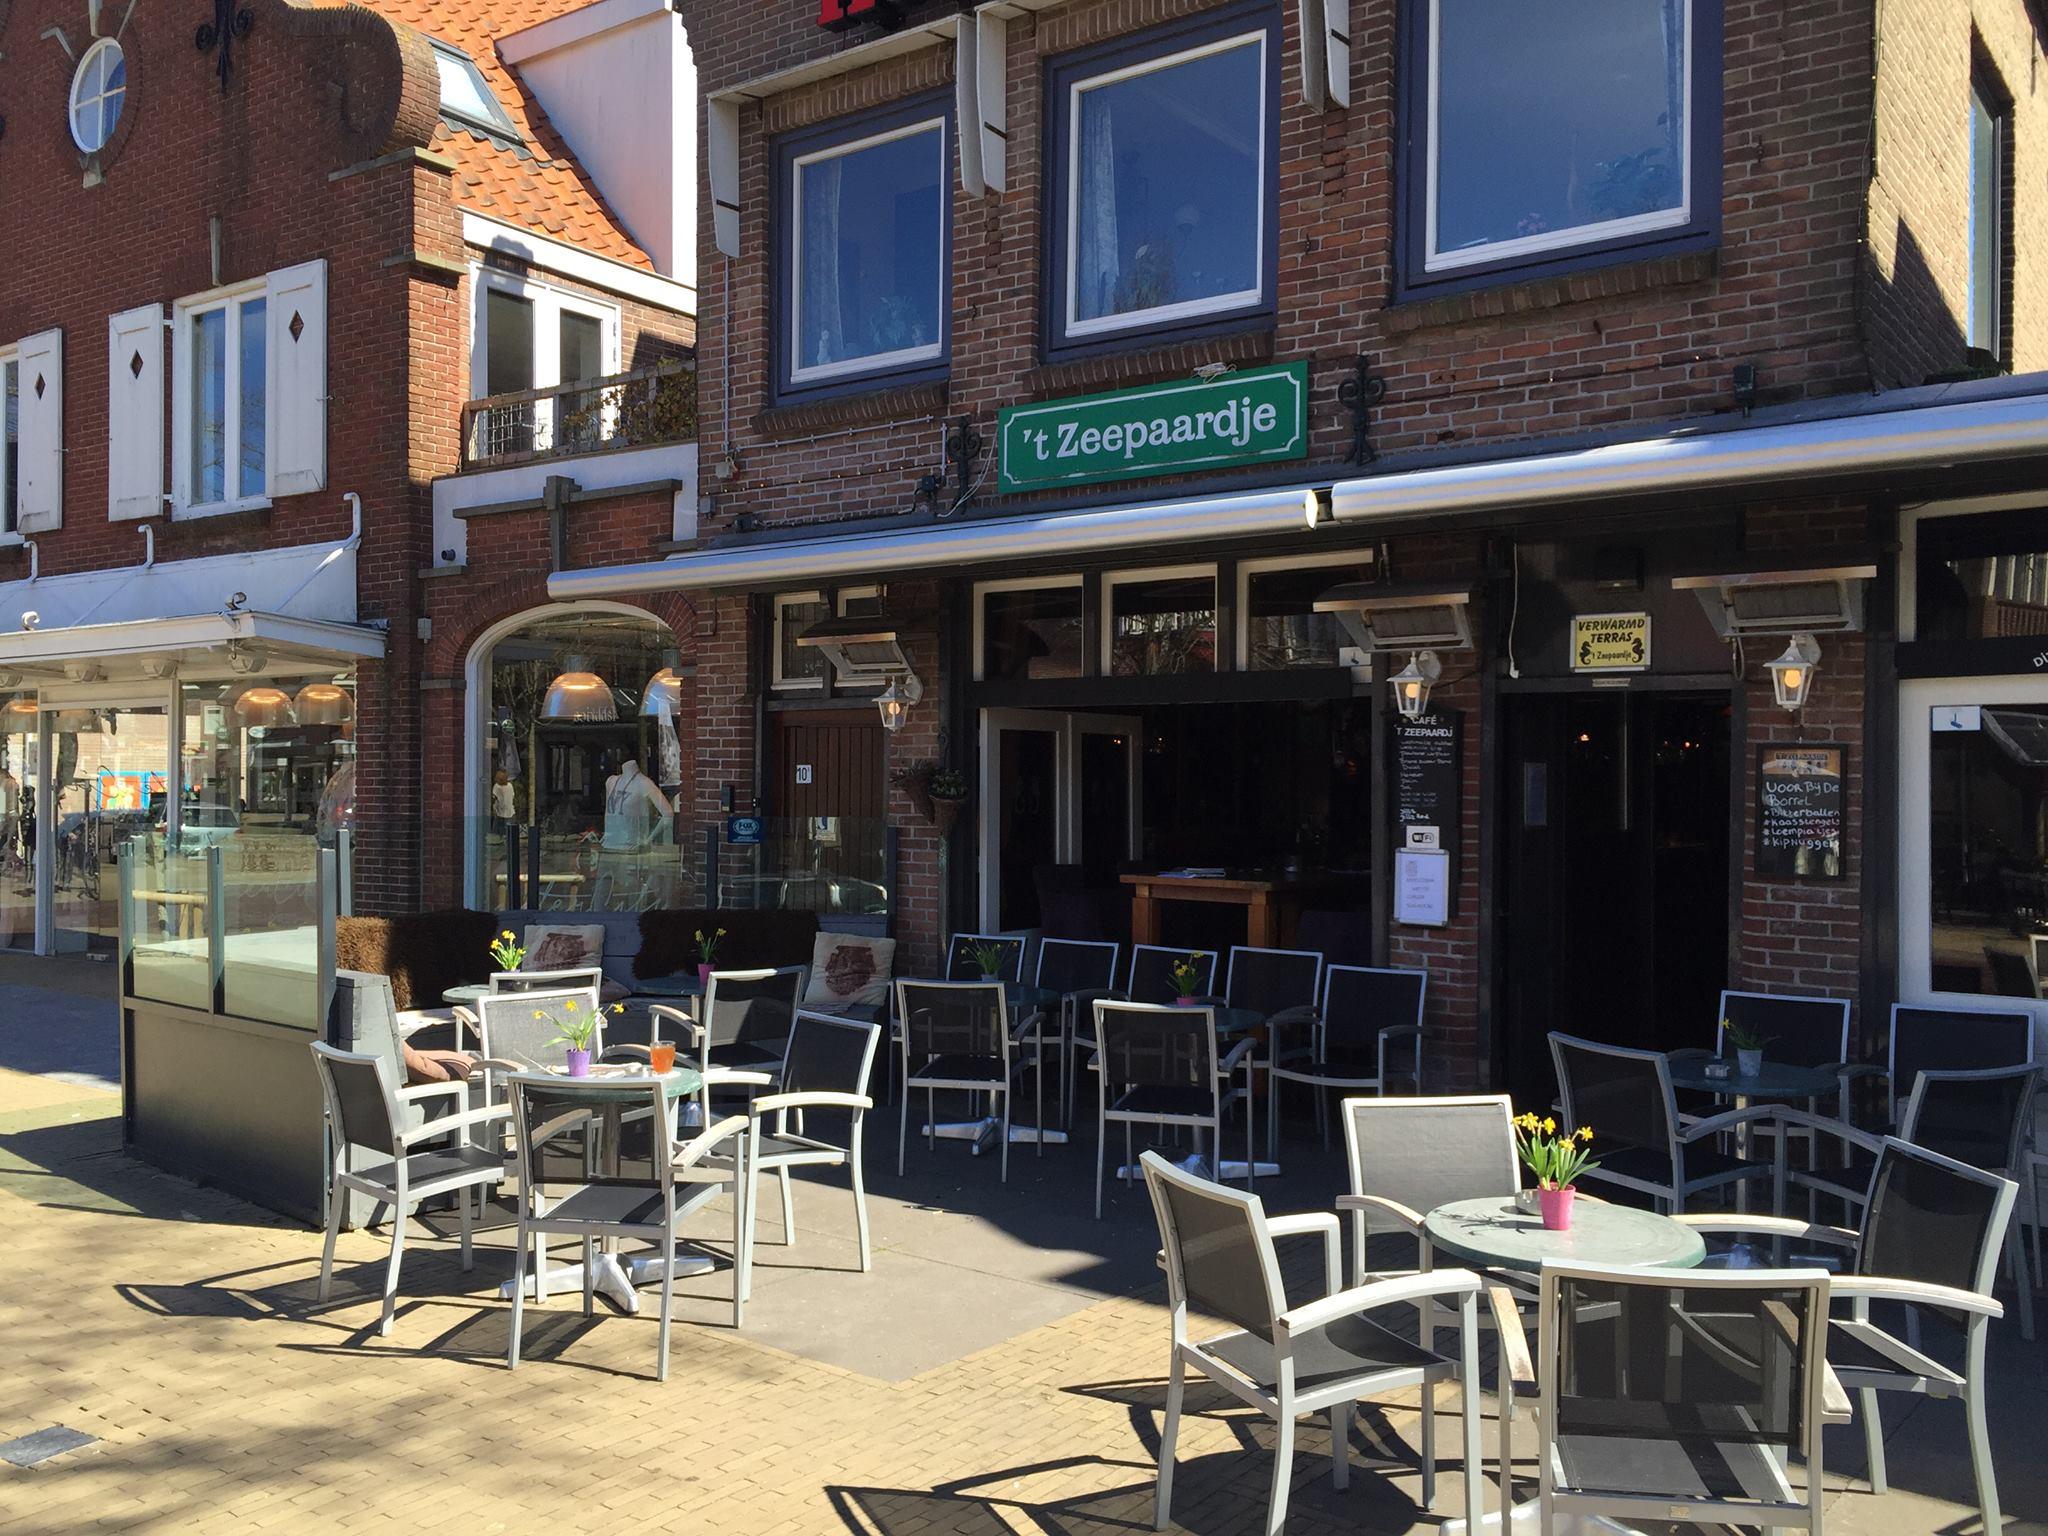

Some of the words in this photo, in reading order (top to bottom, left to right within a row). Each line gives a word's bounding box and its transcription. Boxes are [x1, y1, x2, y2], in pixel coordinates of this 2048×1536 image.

[1022, 429, 1049, 461] 't
[1056, 396, 1277, 459] Zeepaardje
[1578, 618, 1645, 631] VERWARMD
[1590, 631, 1634, 643] TERRAS
